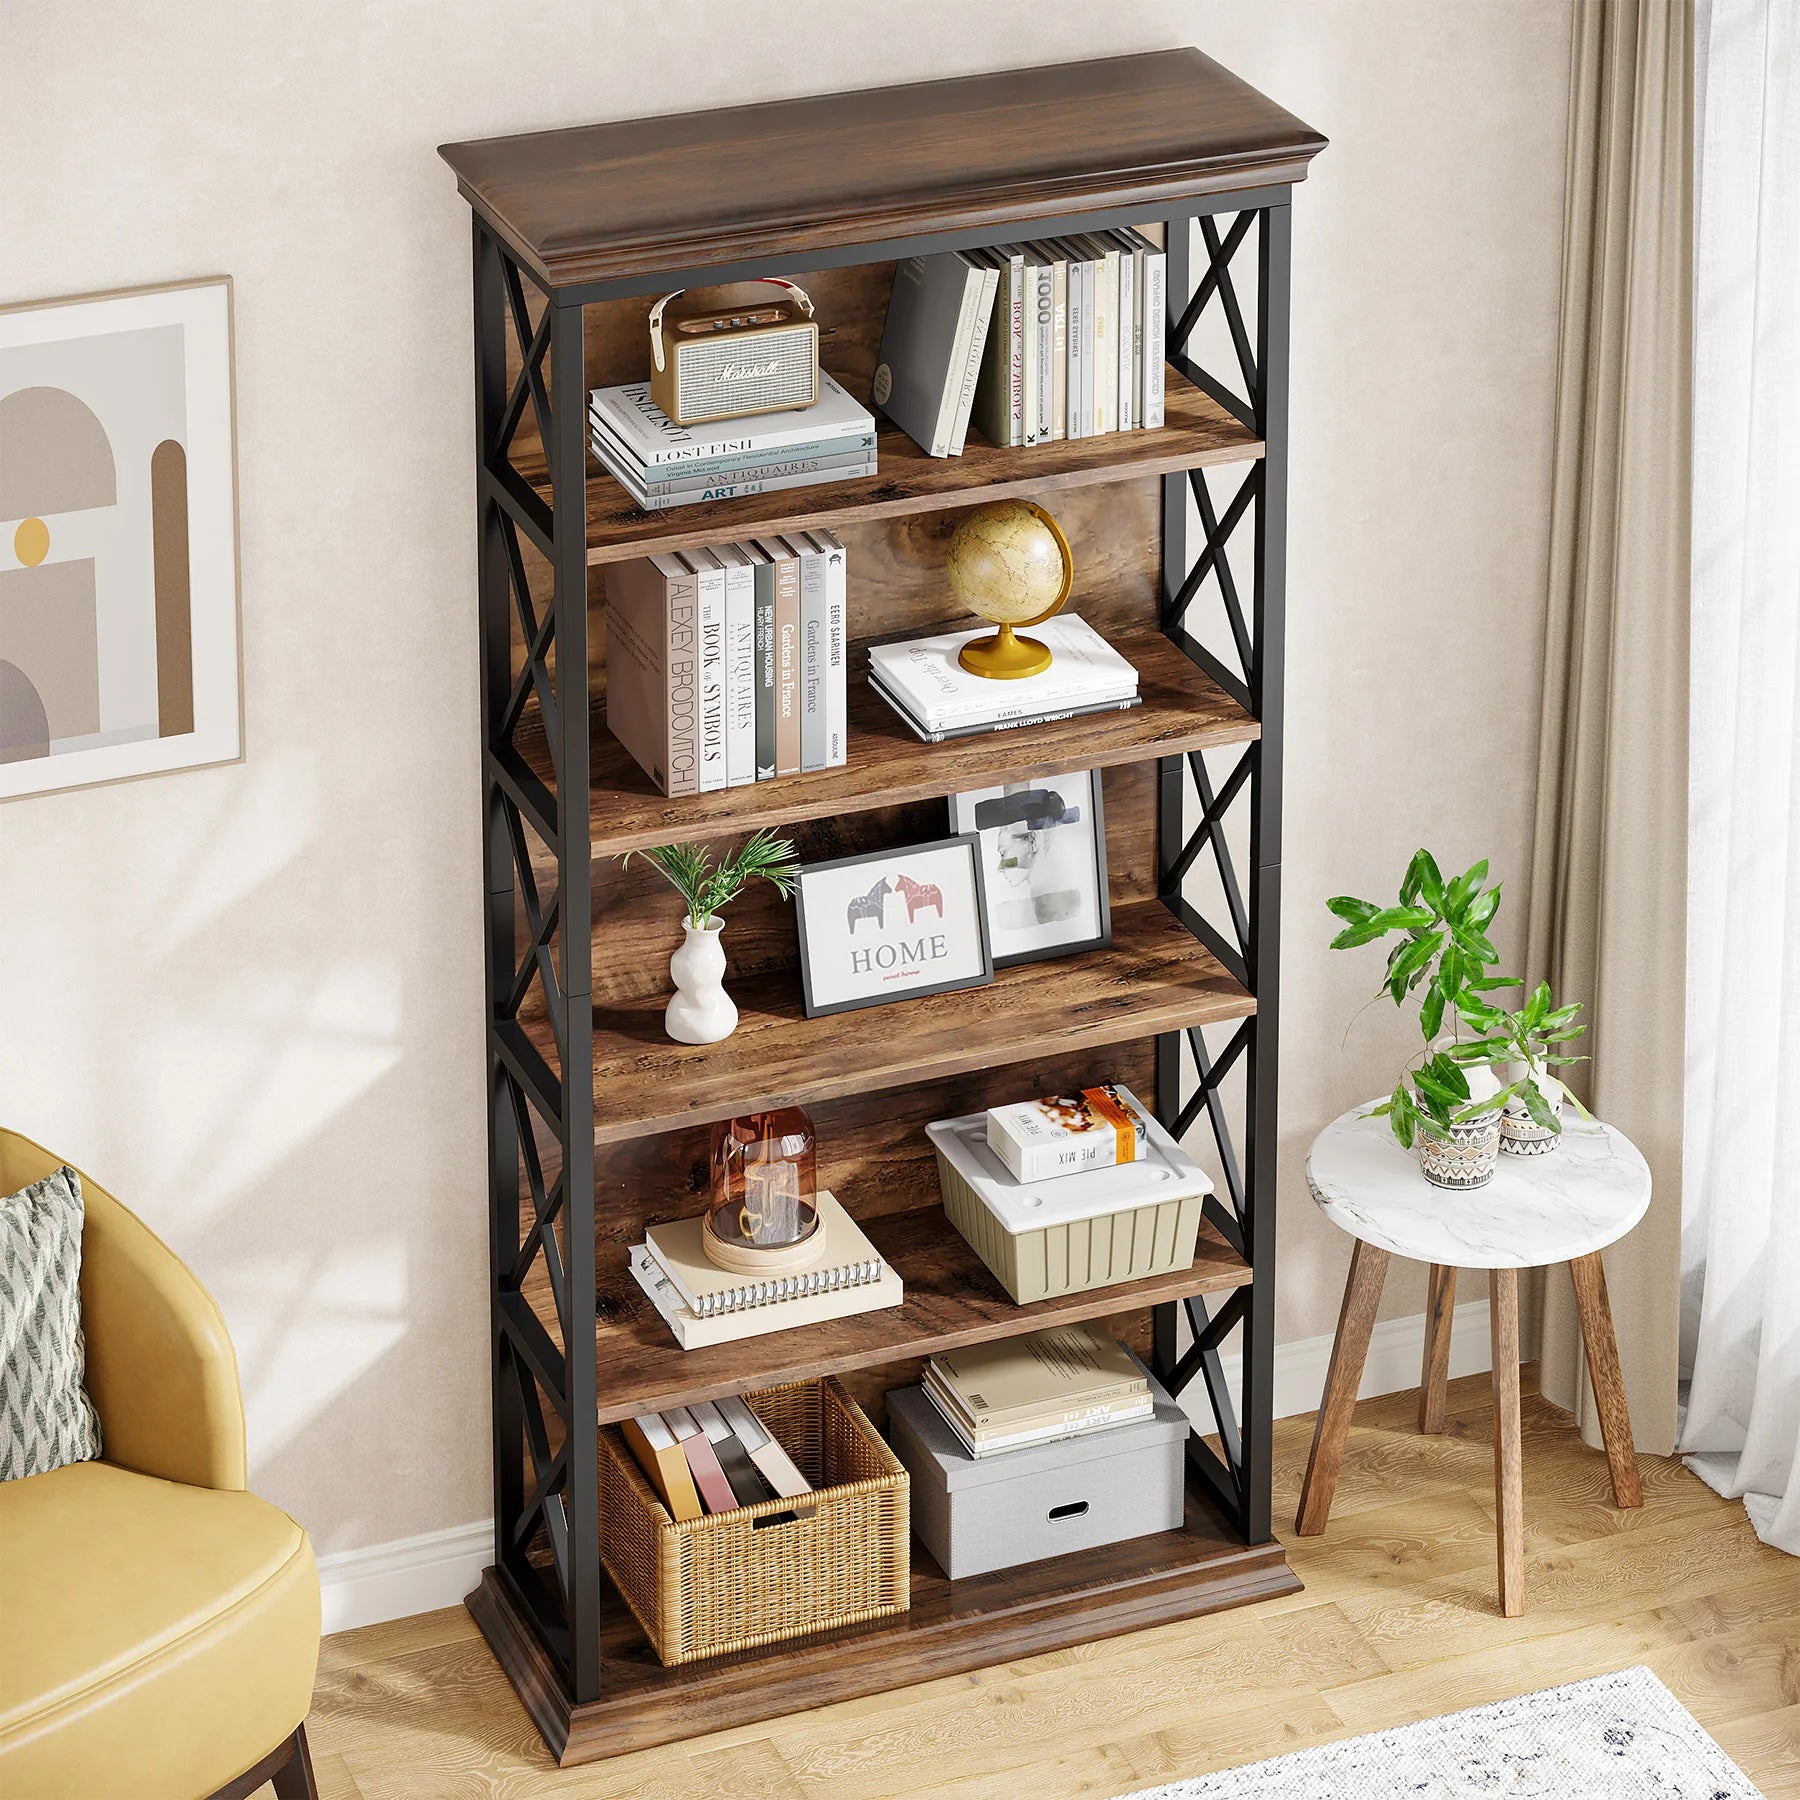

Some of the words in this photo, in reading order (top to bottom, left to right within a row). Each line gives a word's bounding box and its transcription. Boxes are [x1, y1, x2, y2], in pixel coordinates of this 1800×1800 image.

[714, 361, 779, 382] Marshall
[655, 446, 704, 462] LOST
[710, 440, 752, 455] FISH
[666, 464, 686, 472] Detail
[694, 456, 741, 468] Contemporary
[780, 444, 820, 455] Architecture
[666, 470, 692, 478] Virginia
[693, 466, 720, 474] McLeod
[706, 460, 818, 484] ANTIQUAIRES
[701, 486, 738, 500] ART
[671, 583, 694, 654] ALEXEY
[703, 606, 712, 620] THE
[764, 606, 773, 623] NEW
[830, 605, 840, 624] EERO
[703, 623, 720, 669] BOOK
[764, 624, 773, 652] URBAN
[782, 624, 795, 667] Gardens
[807, 620, 820, 663] Gardens
[830, 628, 840, 666] SAARINEN
[704, 672, 712, 682] OF
[735, 622, 752, 730] ANTIQUAIRES
[764, 653, 774, 688] HOUSING
[782, 669, 795, 680] in
[808, 665, 819, 676] in
[782, 682, 795, 718] France
[808, 678, 820, 713] France
[672, 660, 694, 784] BRODOVITCH
[704, 684, 721, 762] SYMBOLS
[994, 721, 1018, 732] FRANK
[1020, 716, 1043, 728] LLOYD
[1044, 712, 1074, 724] WRIGHT
[998, 709, 1024, 719] EAMES
[850, 934, 948, 974] HOME
[1059, 1151, 1076, 1165] MIX
[1082, 1148, 1096, 1160] PIE
